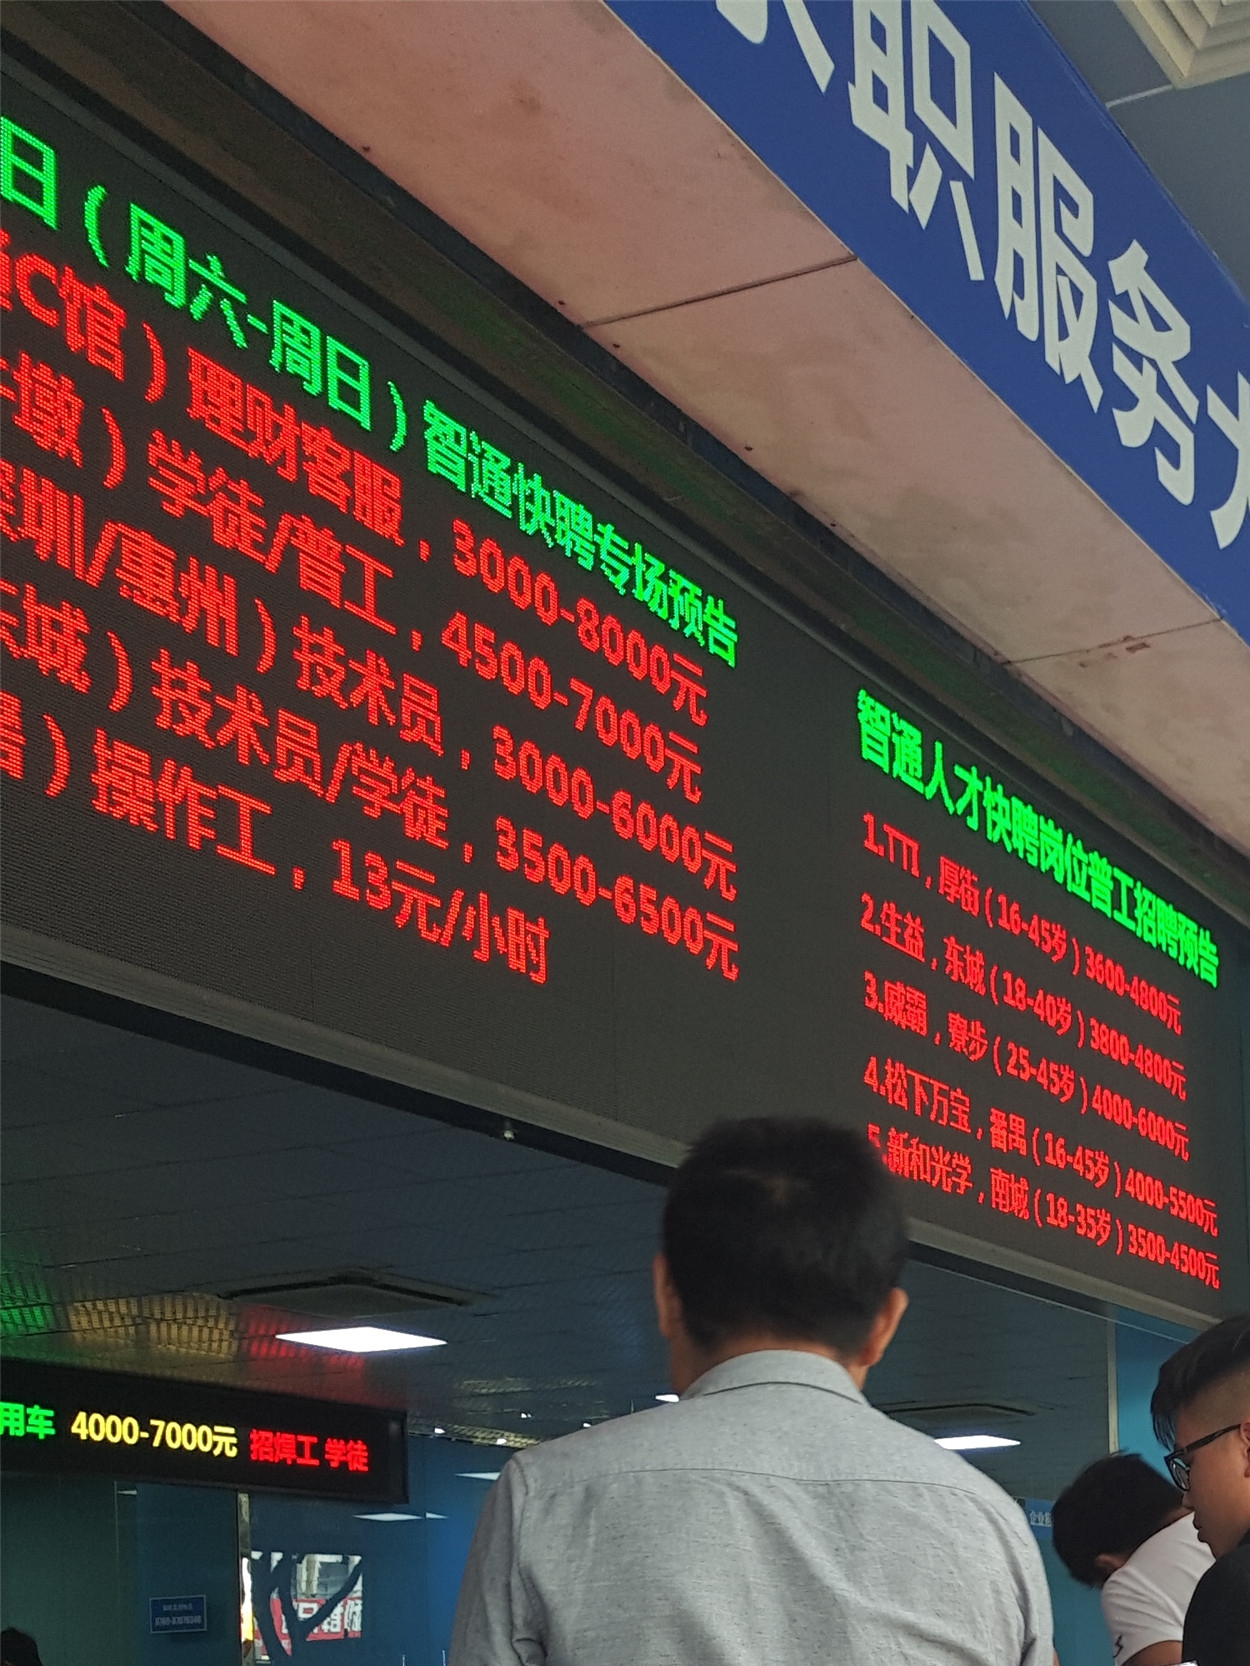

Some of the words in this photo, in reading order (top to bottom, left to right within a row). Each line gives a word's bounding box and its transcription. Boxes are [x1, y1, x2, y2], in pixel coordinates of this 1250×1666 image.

[857, 688, 1220, 988] 智通人才快聘岗位普工招聘预告
[71, 1411, 238, 1458] 4000-7000元
[249, 1428, 320, 1467] 招焊工
[324, 1437, 370, 1473] 学徒
